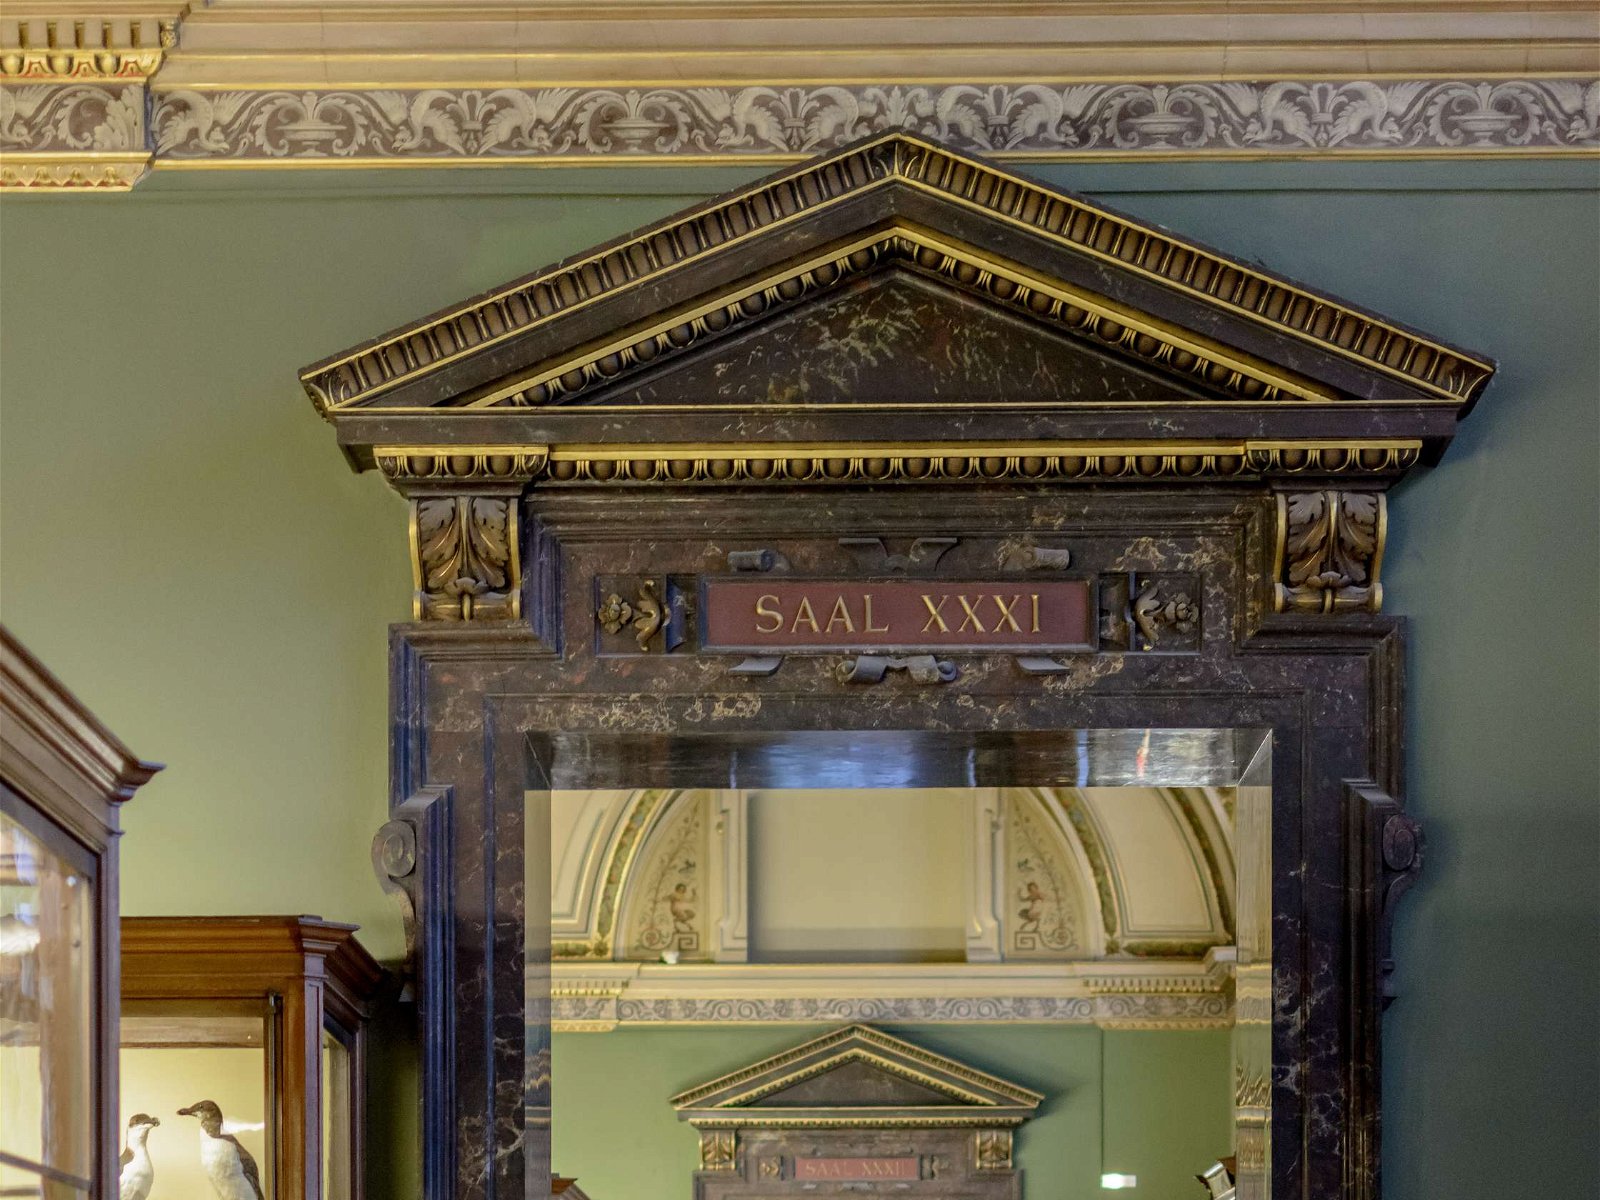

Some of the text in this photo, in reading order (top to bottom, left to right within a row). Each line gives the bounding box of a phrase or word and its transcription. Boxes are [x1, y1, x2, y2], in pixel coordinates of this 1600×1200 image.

[754, 593, 1041, 634] SAAL XXXI
[805, 1161, 905, 1177] SAAL XXXII
